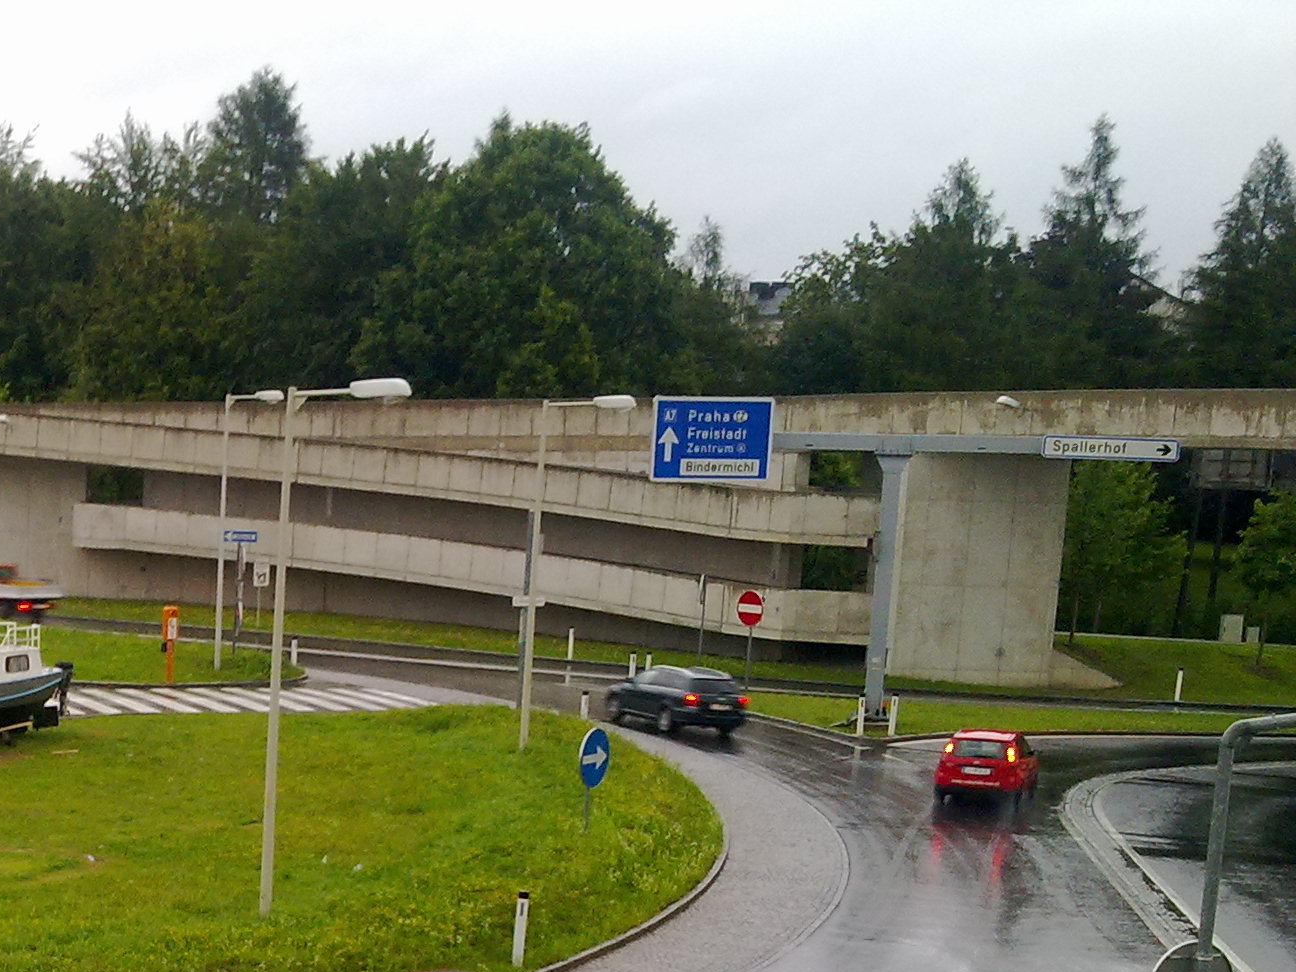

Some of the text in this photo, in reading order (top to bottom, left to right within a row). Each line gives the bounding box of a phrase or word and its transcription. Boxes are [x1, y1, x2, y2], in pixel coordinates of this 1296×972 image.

[688, 409, 730, 422] Praha
[687, 426, 747, 440] Freistadt
[687, 442, 734, 453] Zentrum
[1053, 440, 1127, 455] Spallerhof
[685, 461, 754, 472] Bindermichl
